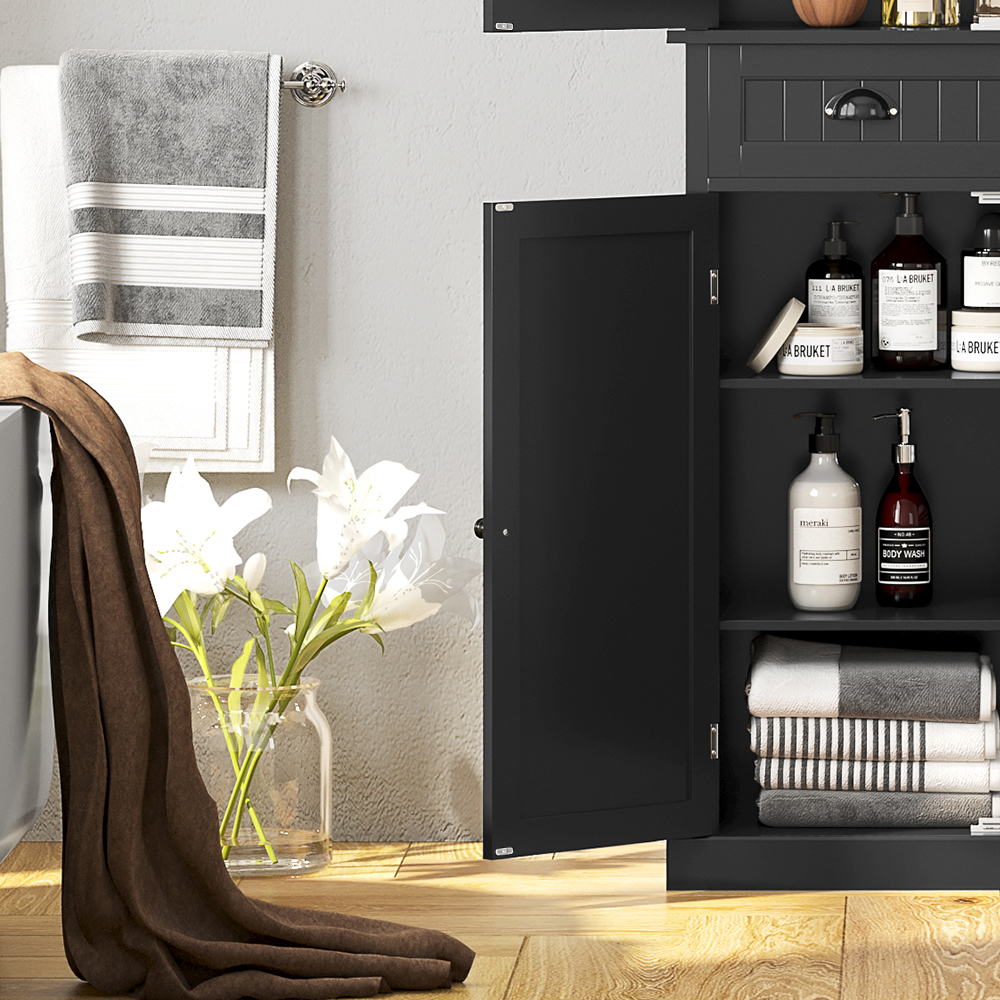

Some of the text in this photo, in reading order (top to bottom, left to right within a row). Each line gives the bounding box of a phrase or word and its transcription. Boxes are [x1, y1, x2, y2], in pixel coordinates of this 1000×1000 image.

[908, 273, 934, 283] BRUKET
[837, 283, 860, 292] BRUKET
[794, 344, 831, 358] BRUKET
[800, 518, 829, 527] meraki
[882, 549, 926, 558] BODY WASH
